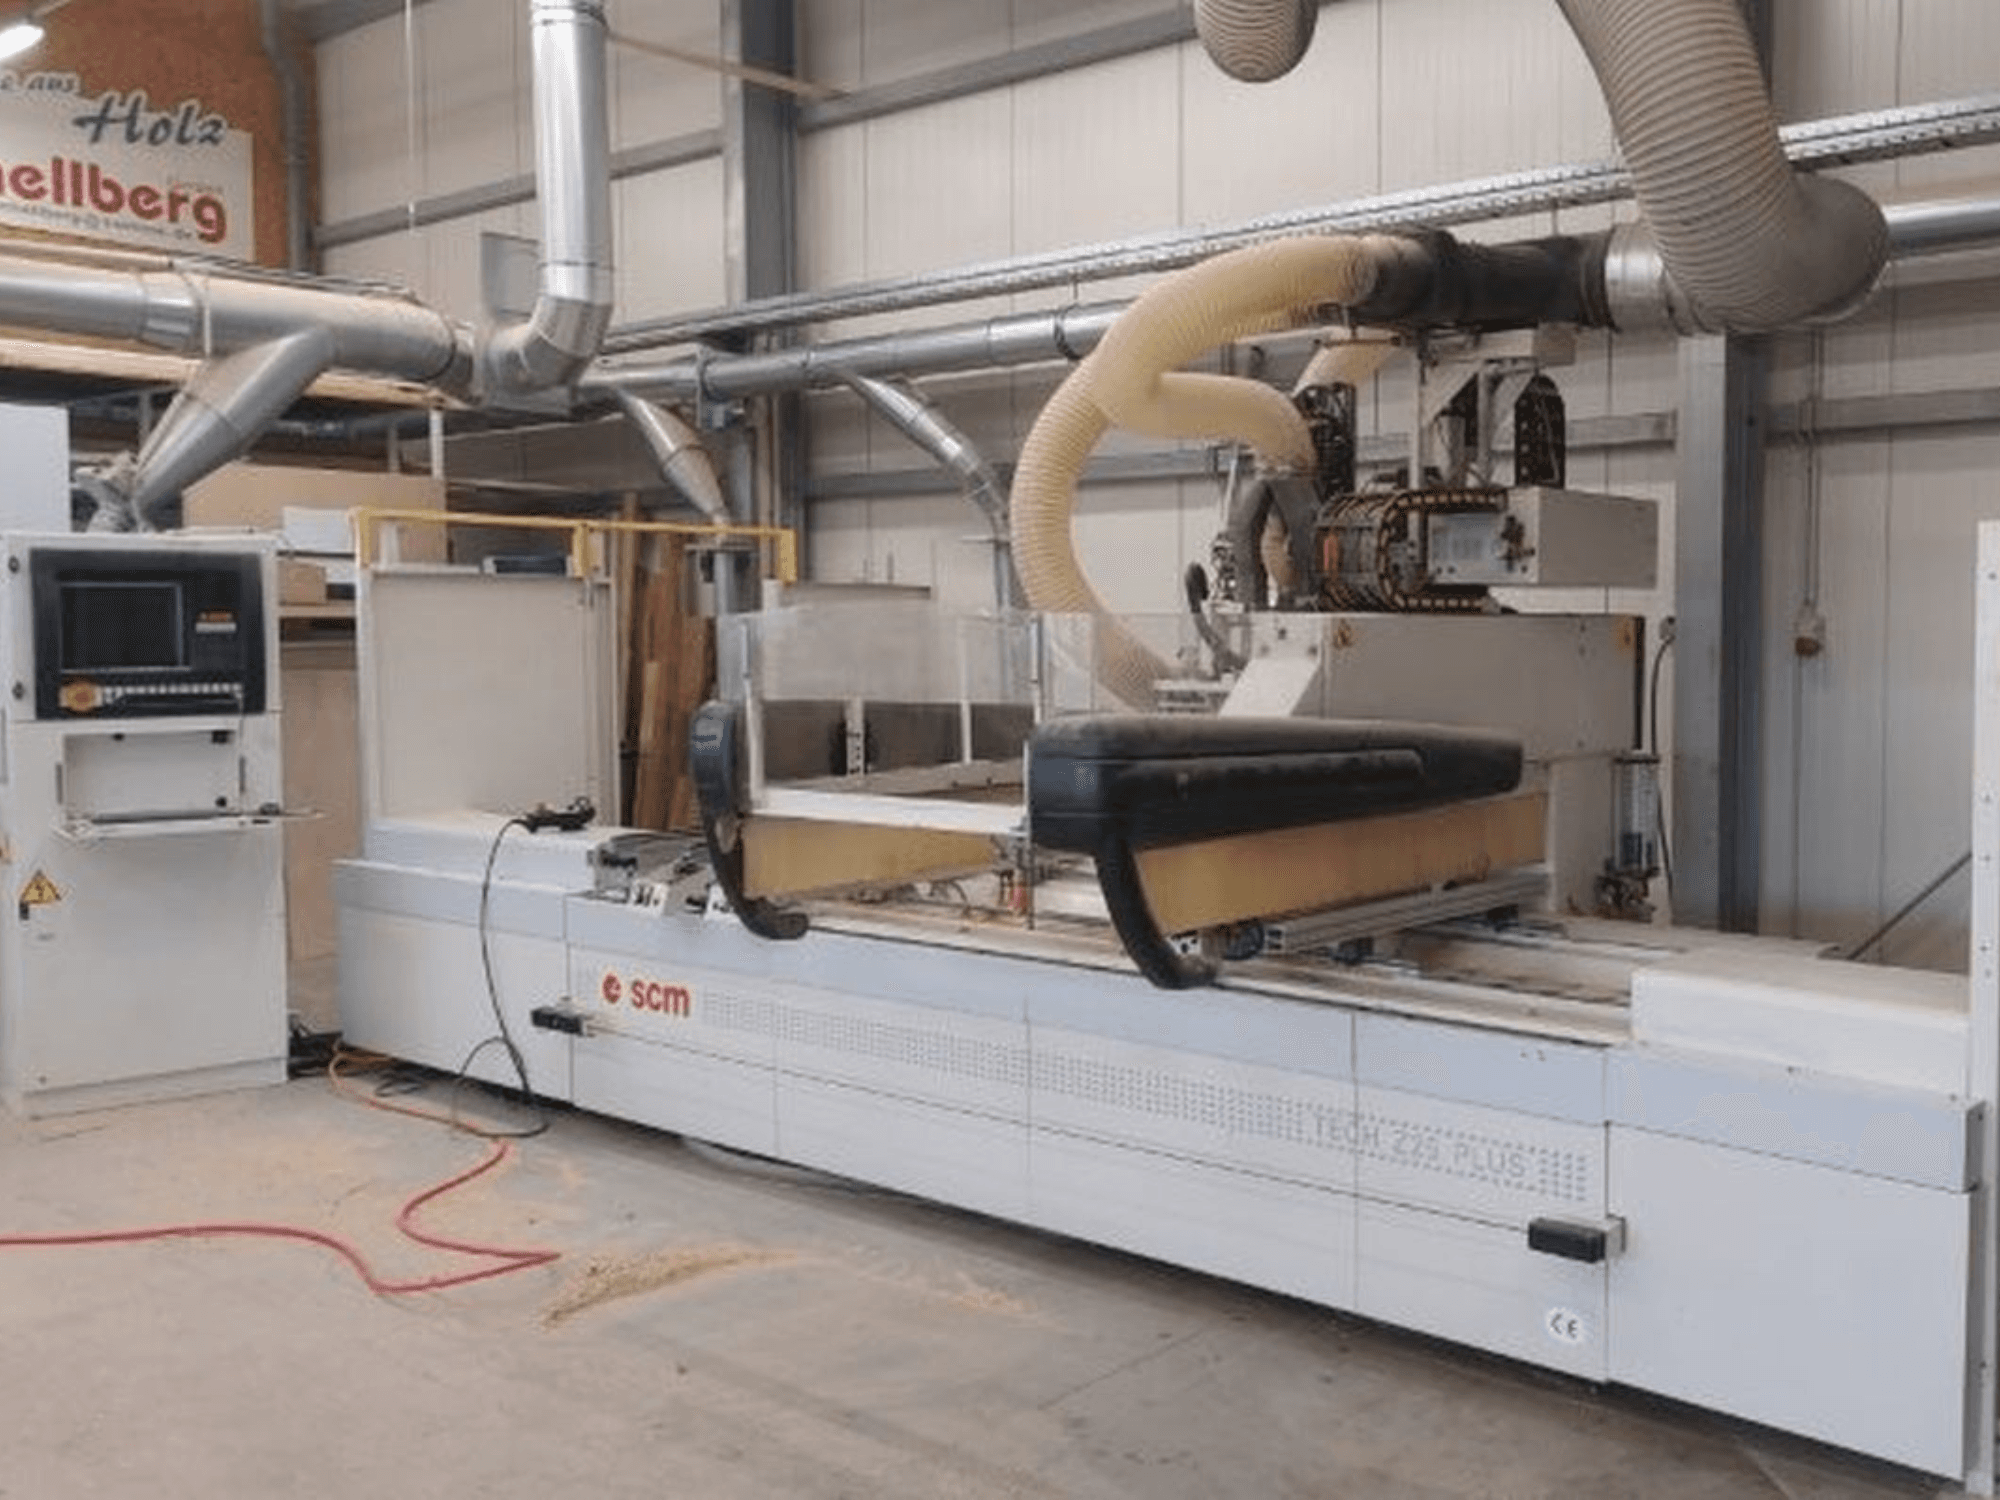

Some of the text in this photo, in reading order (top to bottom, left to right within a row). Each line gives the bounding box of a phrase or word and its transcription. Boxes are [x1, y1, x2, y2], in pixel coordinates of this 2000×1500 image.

[72, 93, 224, 146] Holz
[631, 978, 691, 1018] scm
[1313, 1113, 1380, 1149] TECH
[1453, 1141, 1526, 1178] PLUS
